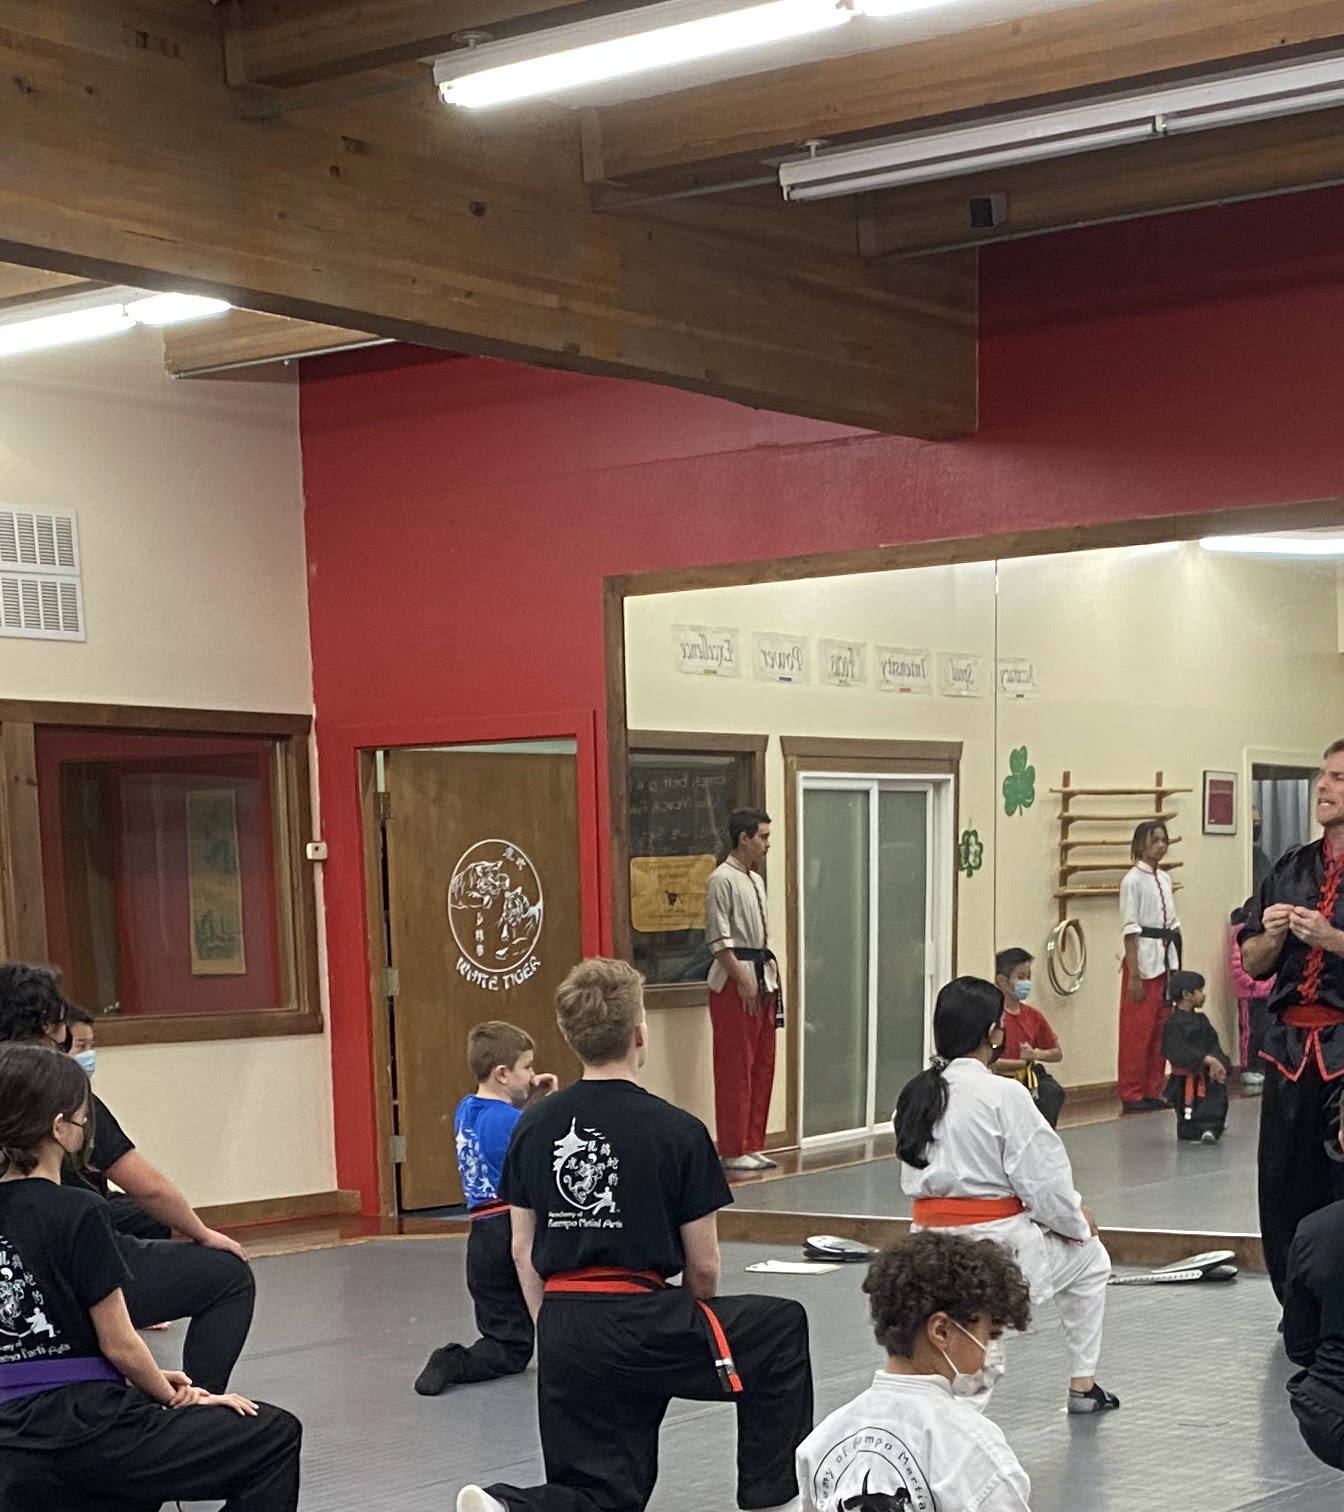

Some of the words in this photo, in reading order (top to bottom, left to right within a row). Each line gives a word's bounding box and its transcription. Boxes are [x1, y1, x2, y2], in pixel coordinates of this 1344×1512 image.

[456, 956, 498, 991] WHITE
[503, 955, 541, 990] TIGER
[835, 1445, 848, 1464] of
